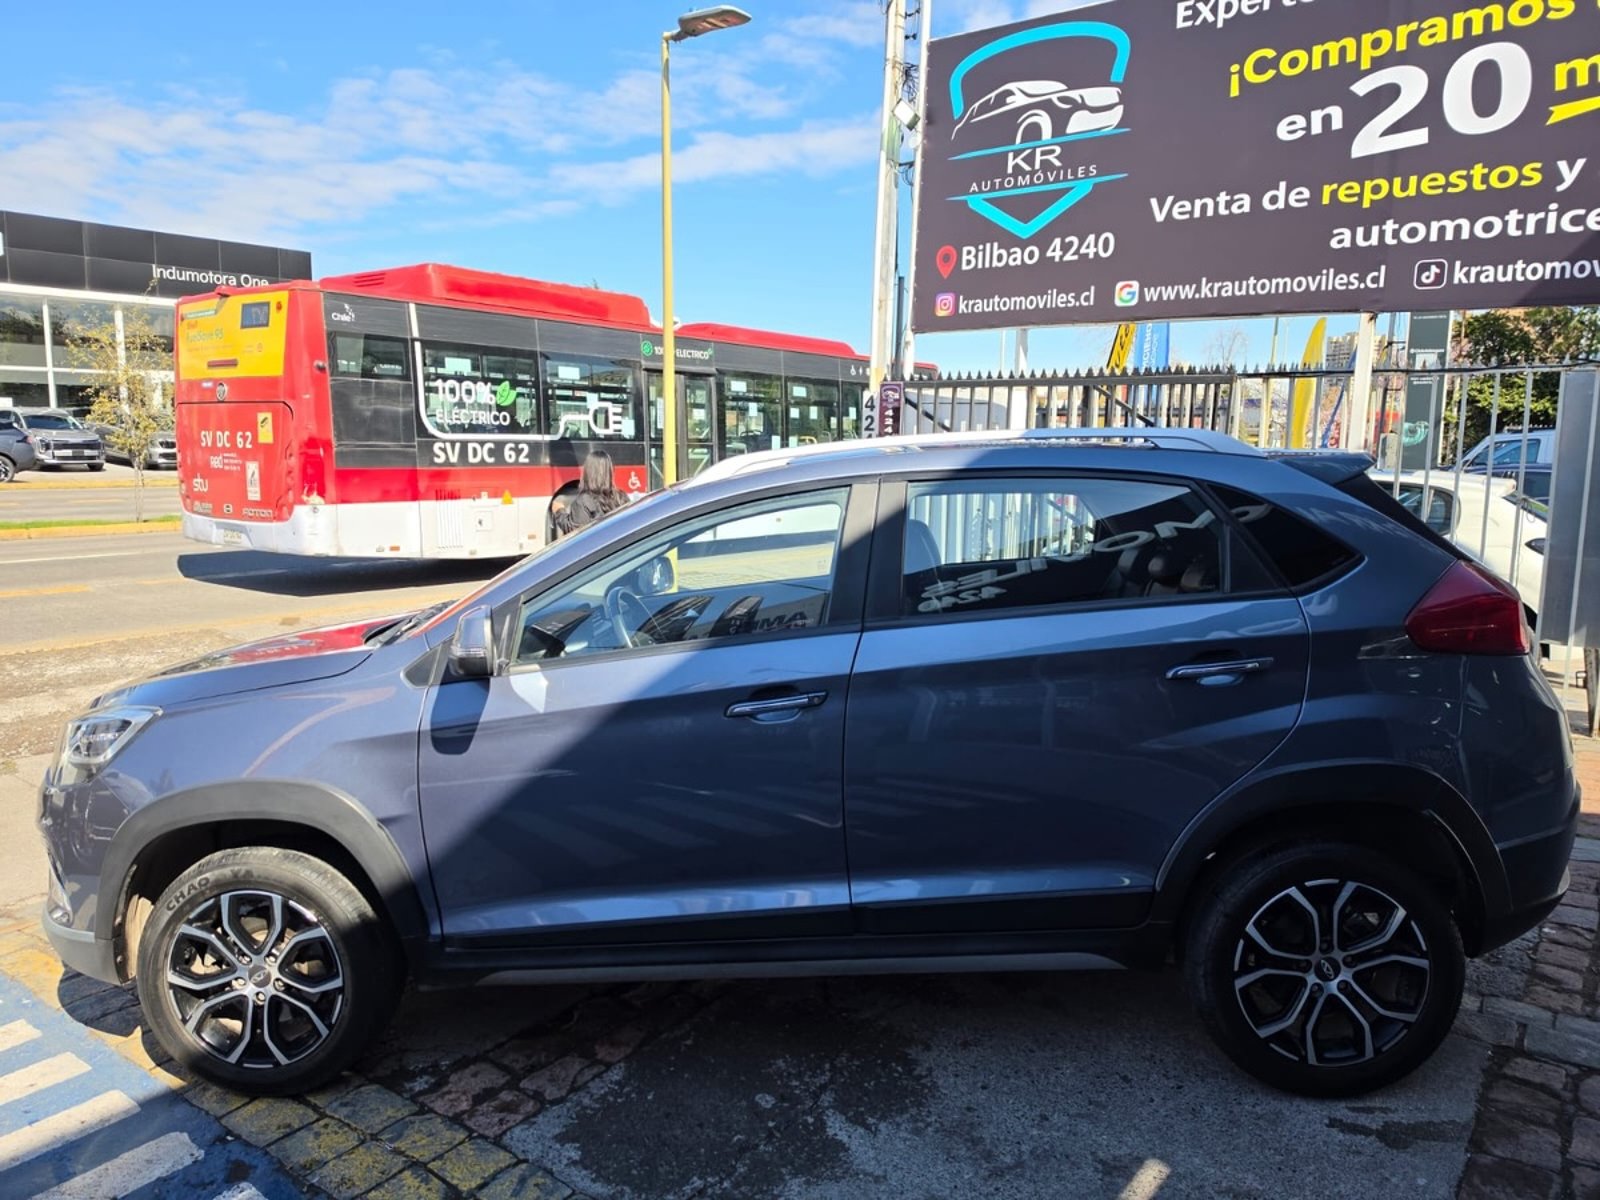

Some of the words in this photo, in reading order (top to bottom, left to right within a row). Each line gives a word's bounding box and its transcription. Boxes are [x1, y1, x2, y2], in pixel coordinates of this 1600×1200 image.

[1276, 105, 1343, 141] en
[1349, 41, 1533, 159] 20
[1006, 144, 1064, 174] KR
[969, 165, 1098, 193] AUTOMÓVILES
[1150, 190, 1251, 223] Venta
[1262, 181, 1310, 211] de
[1321, 161, 1543, 208] repuestos
[1555, 158, 1587, 192] y
[961, 242, 1040, 271] Bilbao
[1046, 232, 1115, 263] 4240
[152, 264, 237, 286] Indumotora
[240, 274, 269, 288] One
[1143, 265, 1387, 302] www.krautomoviles.cl
[958, 286, 1096, 314] krautomoviles.cl
[434, 379, 496, 405] 100%
[864, 394, 876, 439] 42
[200, 430, 213, 447] SV
[216, 431, 231, 448] DC
[236, 431, 253, 449] 62
[432, 441, 460, 464] SV
[467, 442, 495, 464] DC
[503, 443, 530, 464] 62
[165, 876, 211, 912] CHAO
